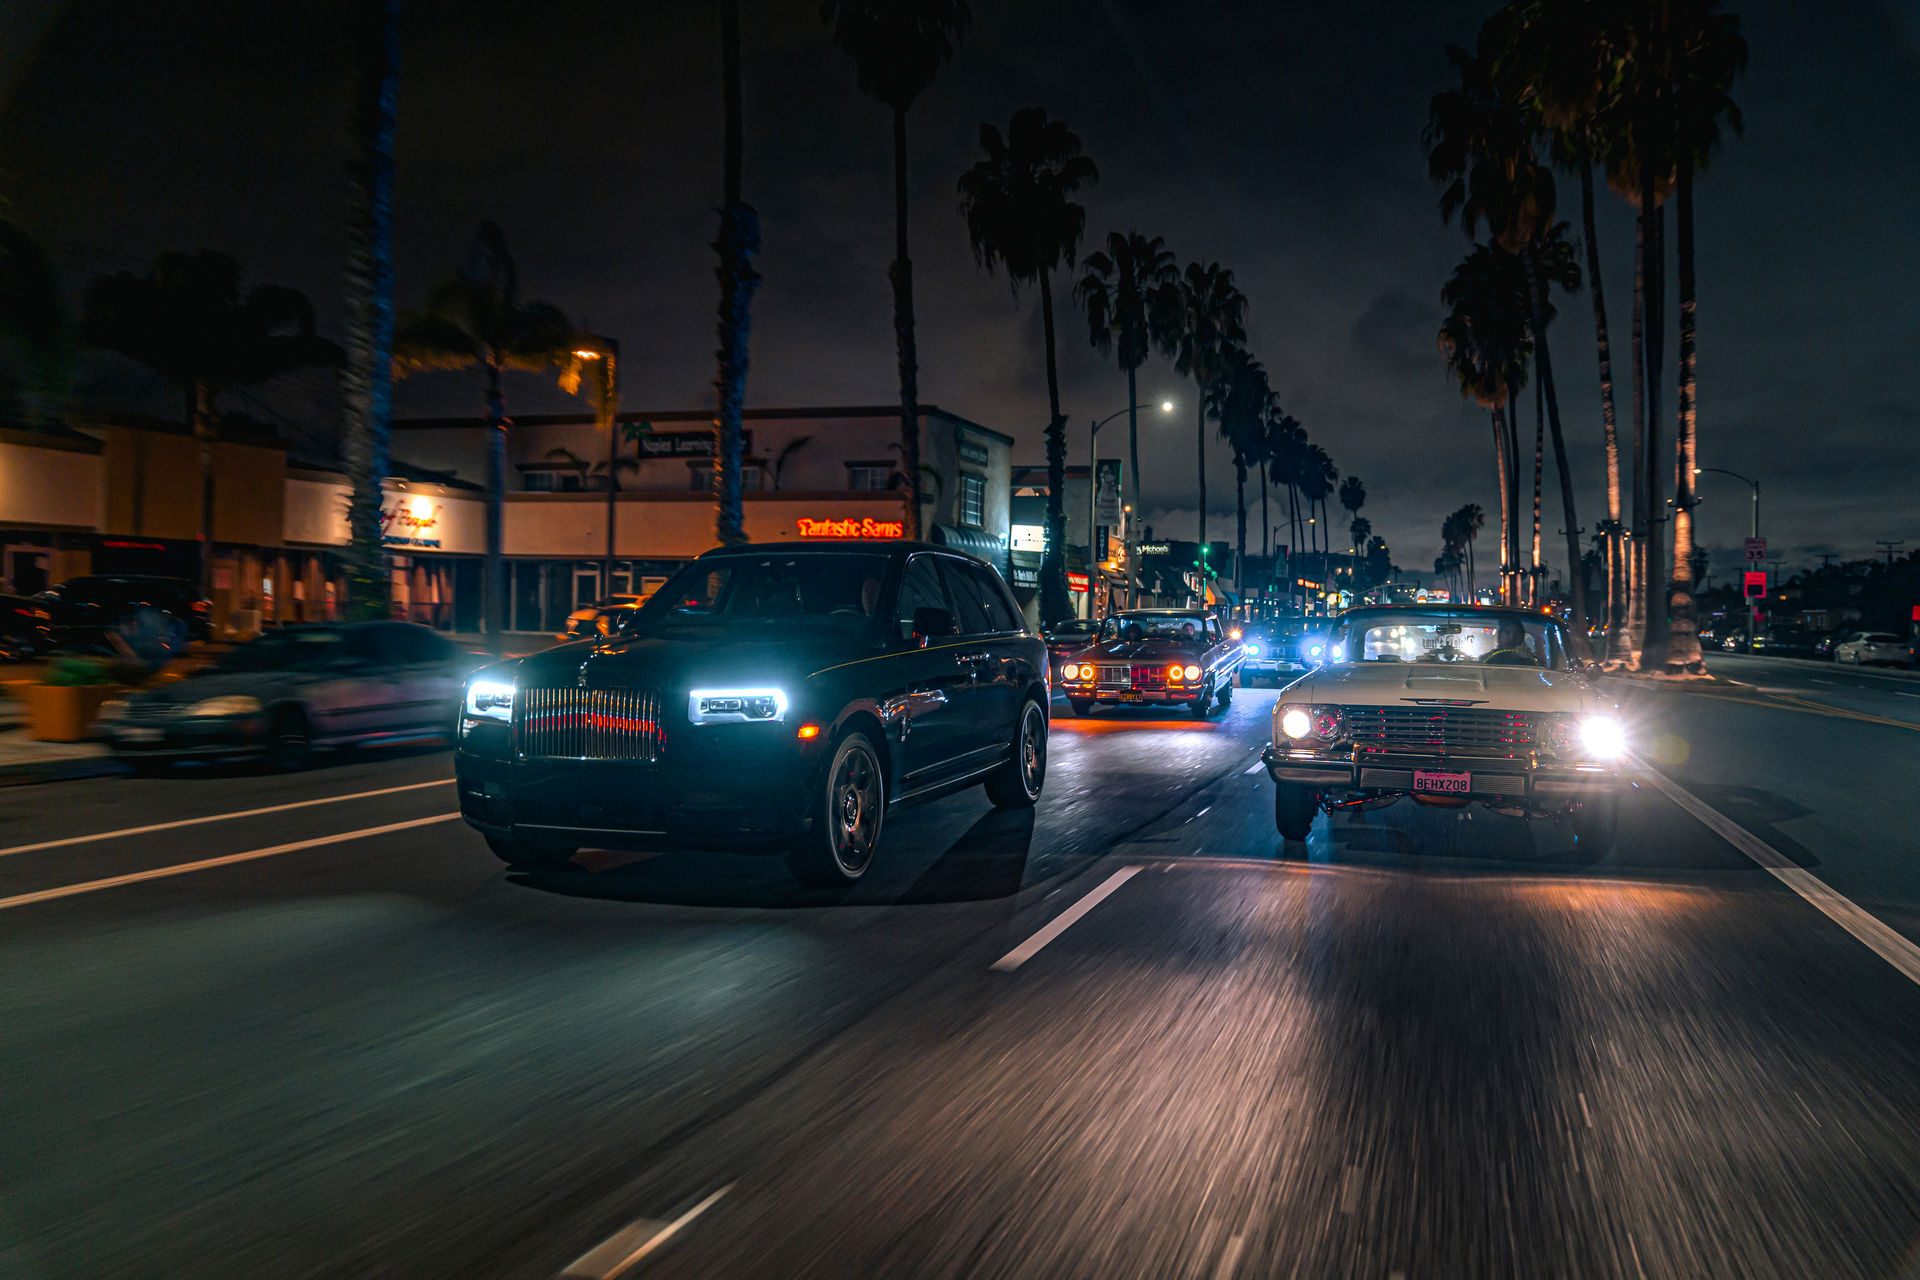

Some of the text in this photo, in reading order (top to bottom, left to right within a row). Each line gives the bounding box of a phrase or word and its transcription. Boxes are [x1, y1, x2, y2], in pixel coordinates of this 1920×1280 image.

[797, 517, 904, 538] Fantastic Sams
[1748, 550, 1765, 560] 35
[1416, 777, 1468, 791] 8EHX208
